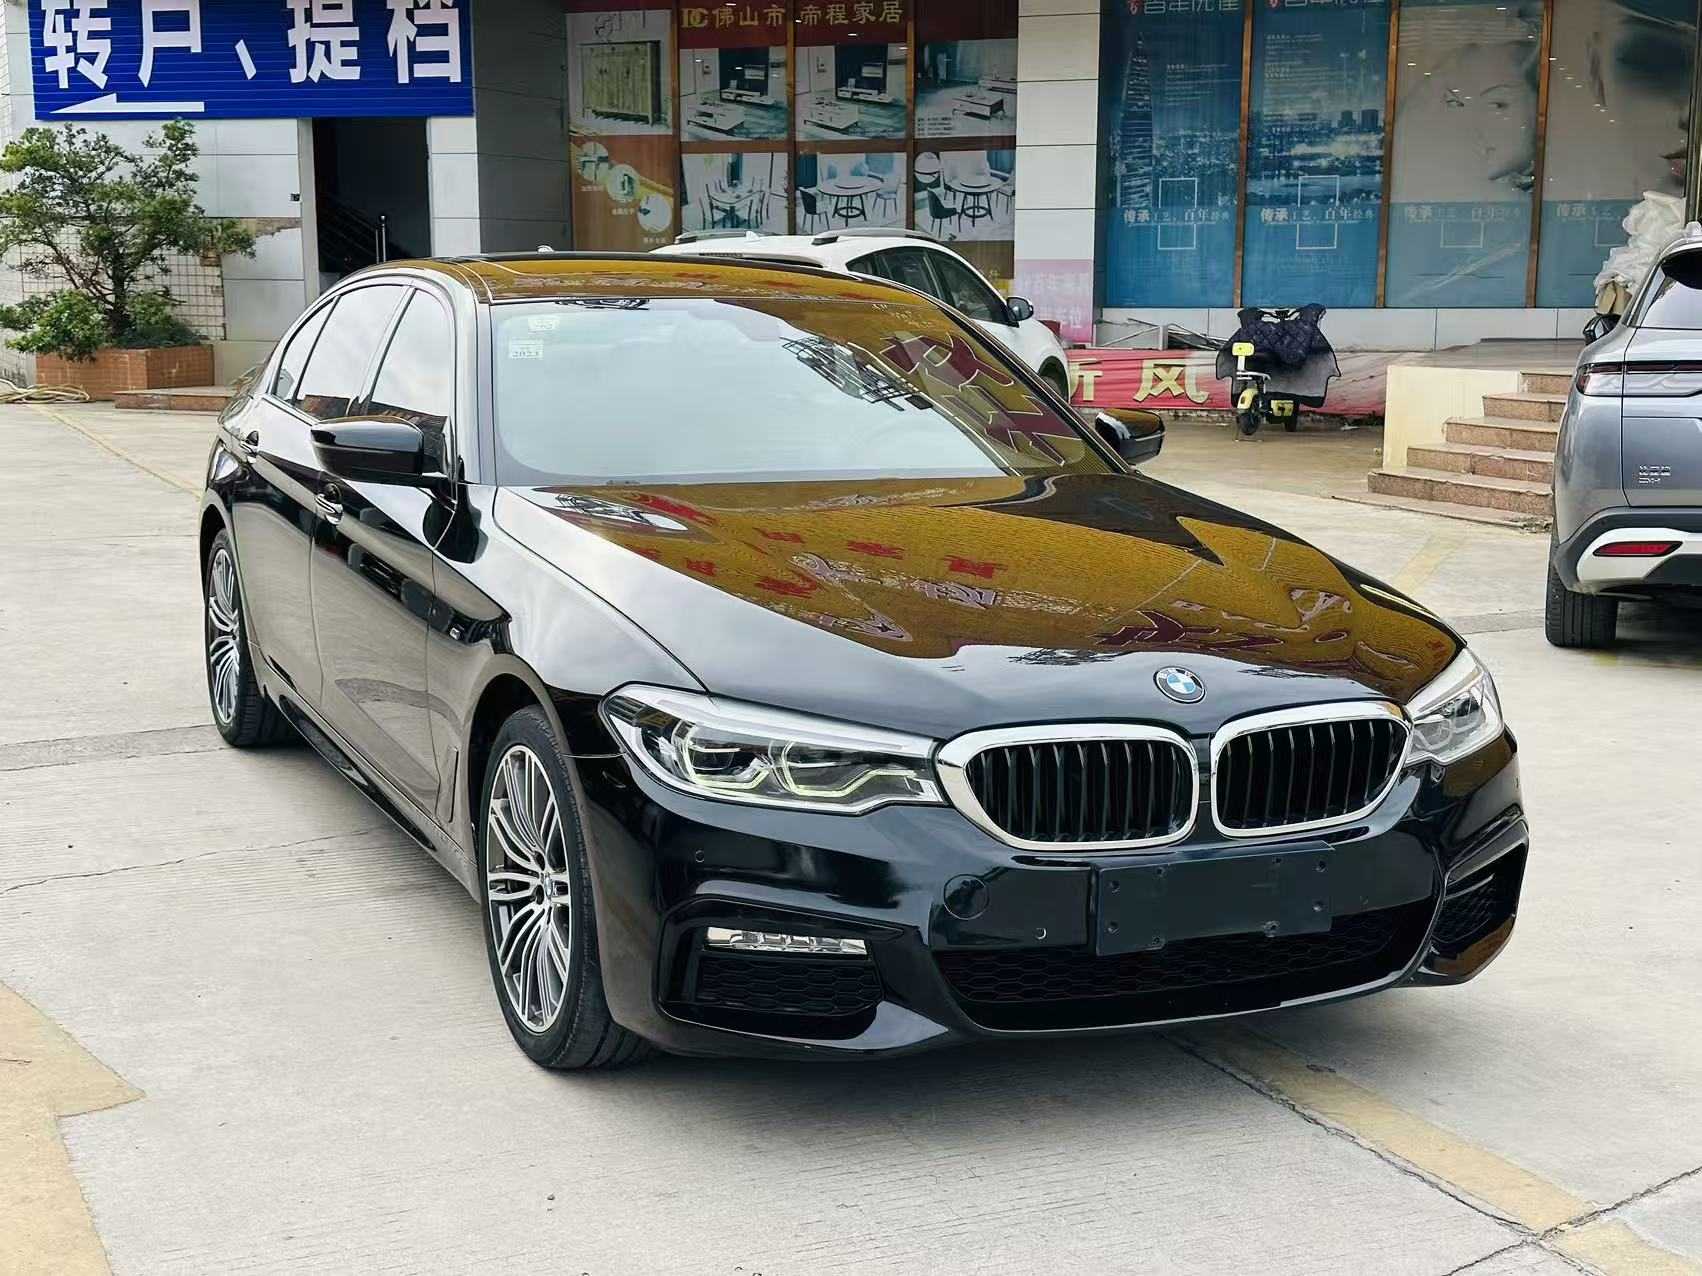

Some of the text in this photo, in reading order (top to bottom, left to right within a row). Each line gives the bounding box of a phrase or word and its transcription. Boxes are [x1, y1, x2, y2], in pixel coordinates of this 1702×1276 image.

[712, 6, 786, 27] 佛山市
[800, 1, 904, 25] 帝程家居
